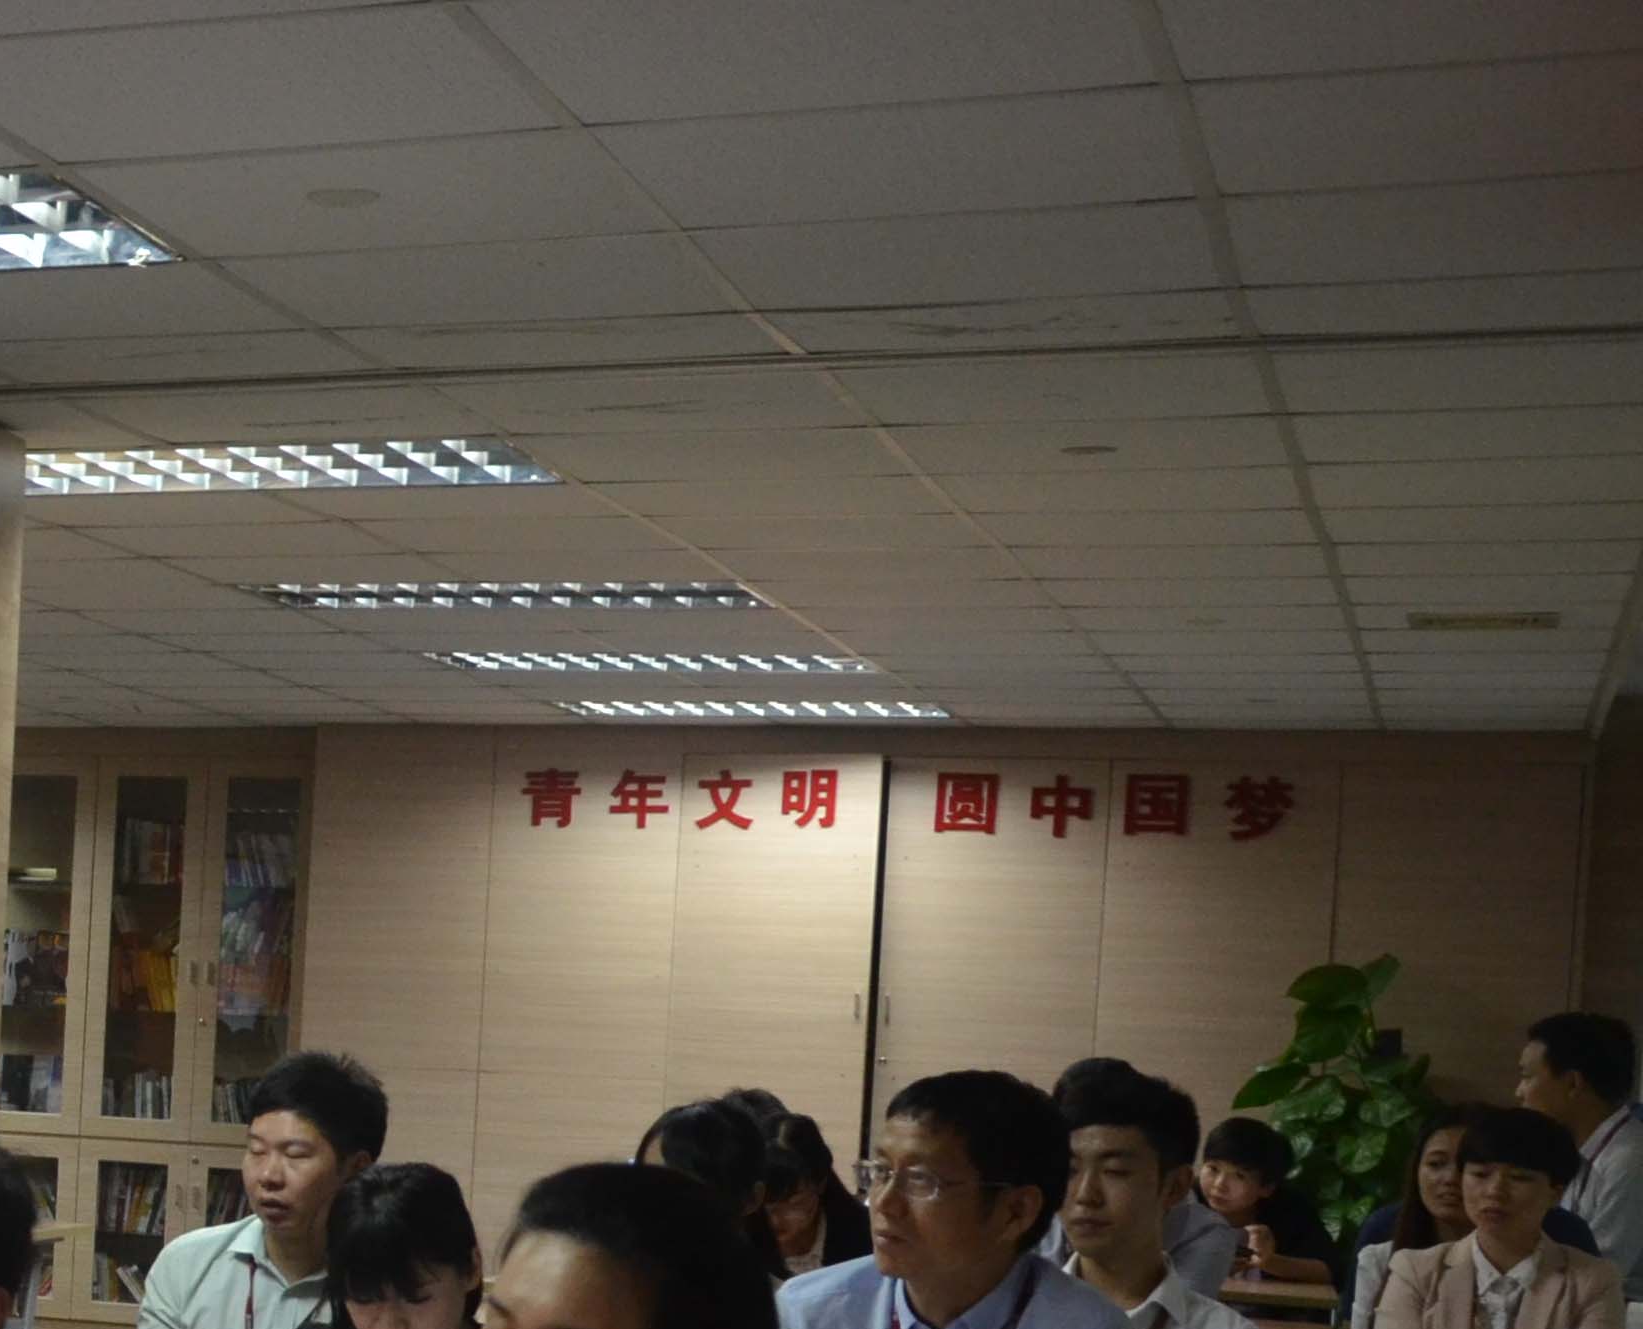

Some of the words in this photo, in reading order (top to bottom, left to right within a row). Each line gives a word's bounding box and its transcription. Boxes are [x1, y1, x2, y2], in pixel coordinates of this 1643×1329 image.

[520, 768, 838, 830] 青年文明
[933, 772, 1295, 842] 圆中国梦
